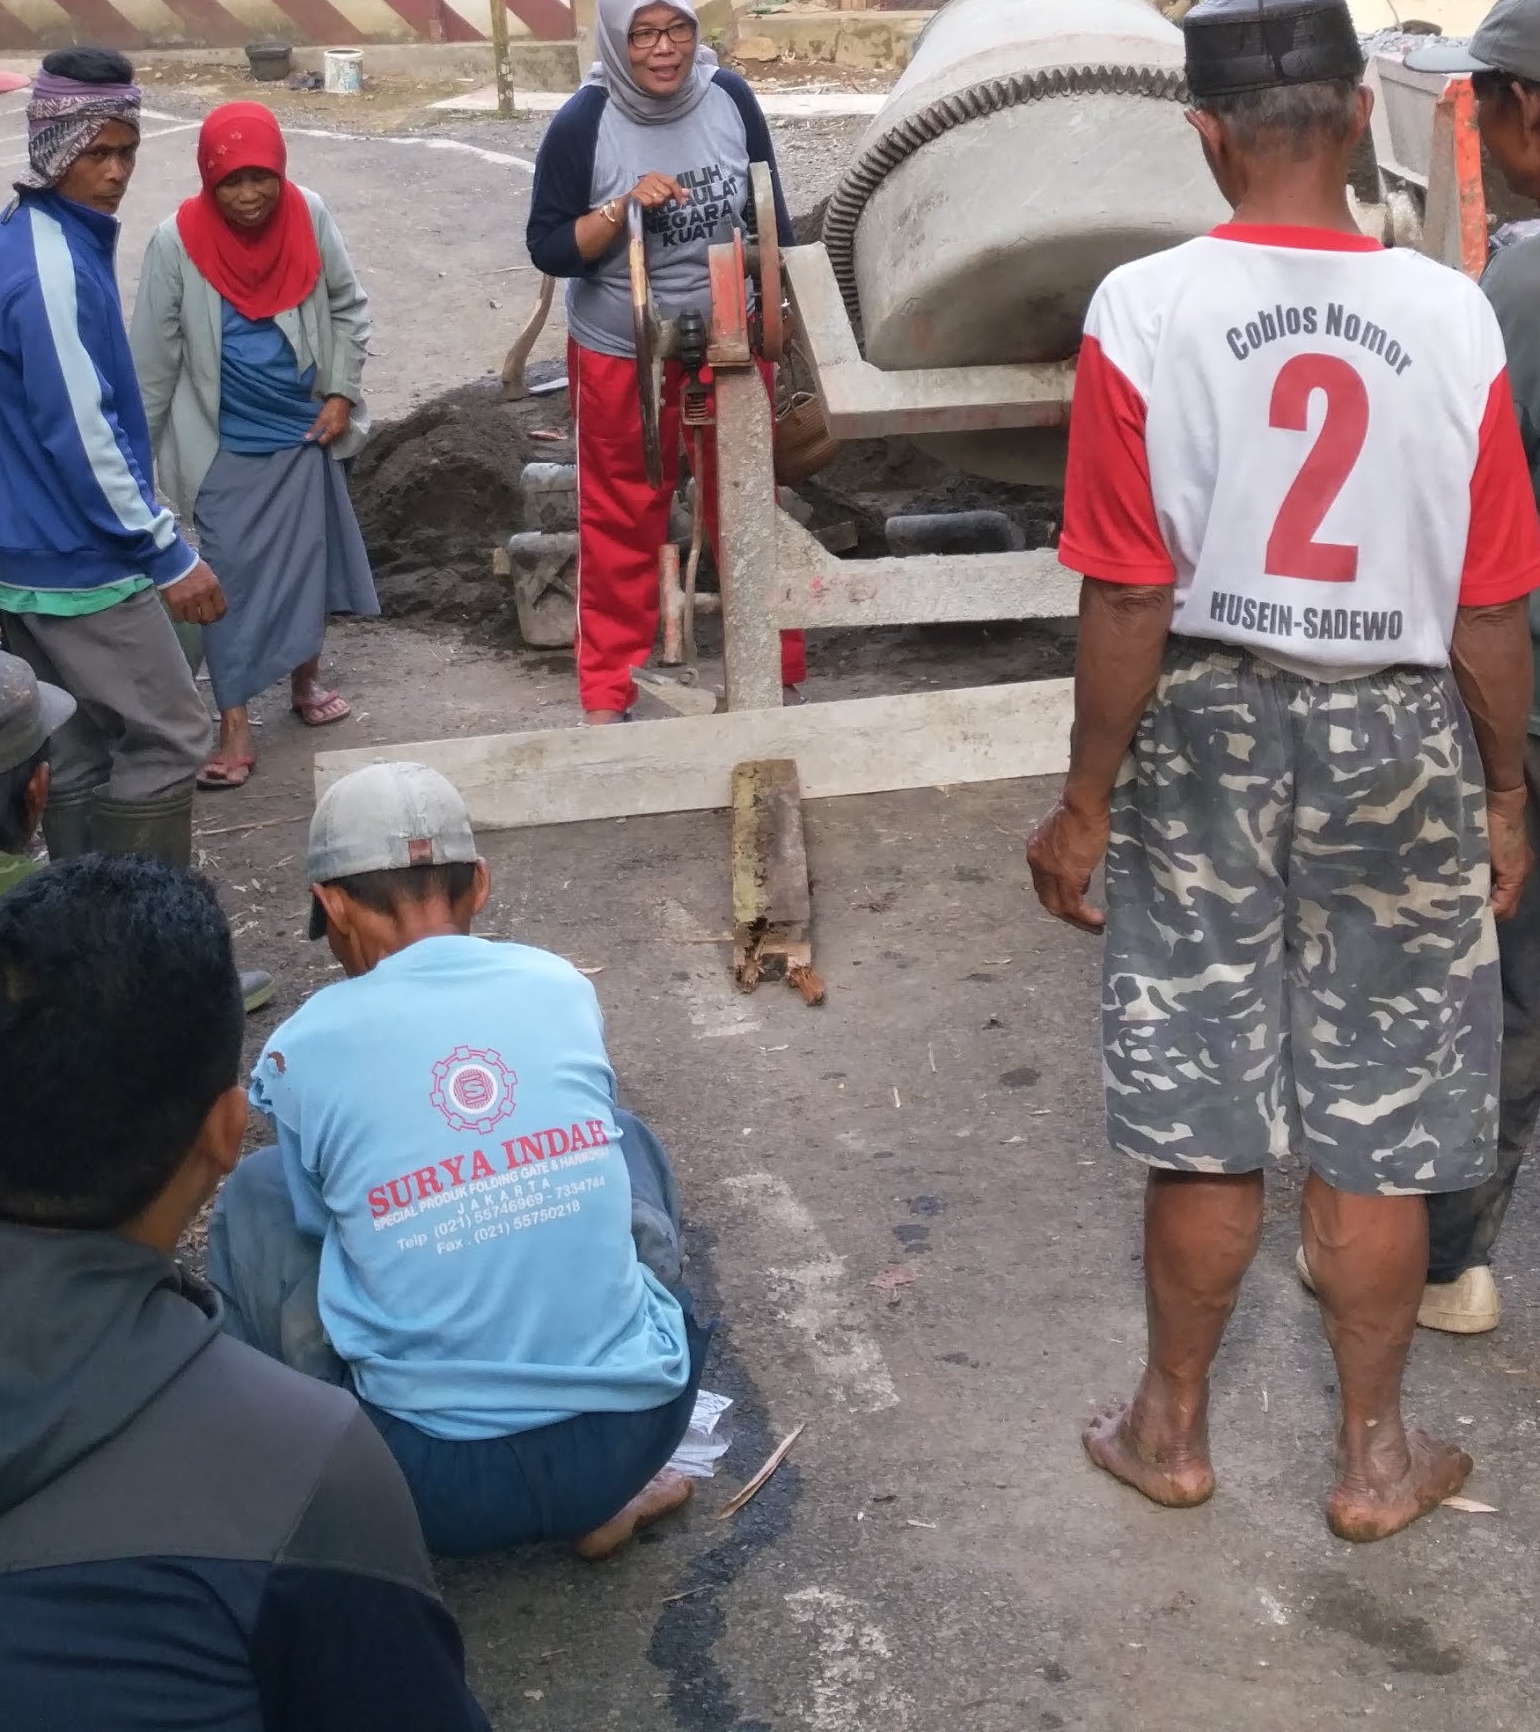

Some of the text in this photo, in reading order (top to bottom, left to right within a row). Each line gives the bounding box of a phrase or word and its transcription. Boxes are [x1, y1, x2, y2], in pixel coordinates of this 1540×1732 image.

[643, 199, 733, 235] NEGARA
[663, 221, 718, 248] KUAT
[1226, 302, 1413, 377] Coblos Nomor
[1264, 353, 1369, 583] 2
[1211, 591, 1403, 641] HUSEIN-SADEWO
[368, 1120, 609, 1219] SURYA INDAH
[373, 1206, 419, 1231] SPECIAL
[419, 1186, 468, 1213] PRODUK
[469, 1171, 519, 1195] FOLDING
[520, 1161, 550, 1180] GATE
[434, 1214, 472, 1239] (021)
[436, 1238, 464, 1255] Fax
[474, 1221, 510, 1245] (021)
